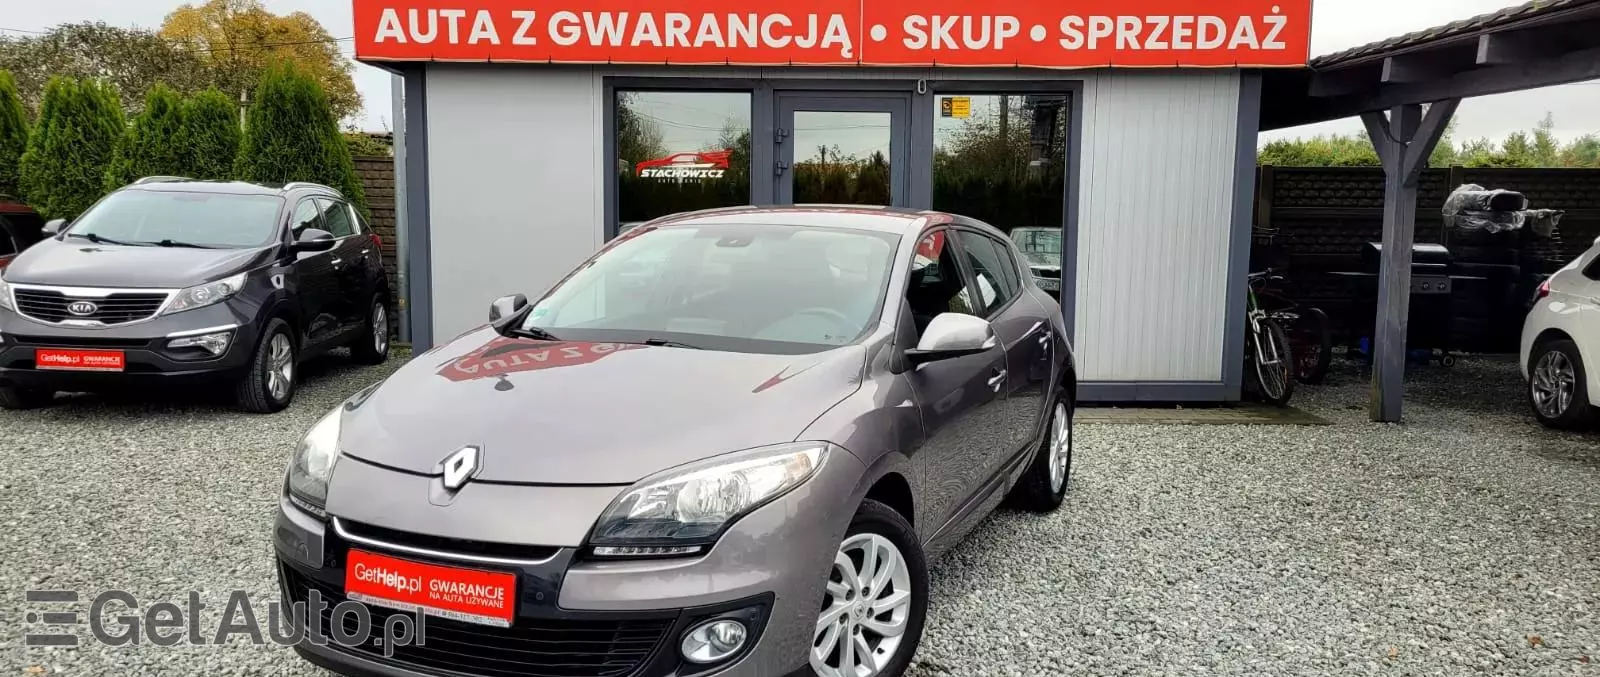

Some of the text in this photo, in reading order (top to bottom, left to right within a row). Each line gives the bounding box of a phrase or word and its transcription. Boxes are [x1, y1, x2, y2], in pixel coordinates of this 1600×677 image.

[375, 5, 1287, 59] AUTA Z GWARANCJĄ SKUP SPRZEDAŻ
[640, 169, 725, 178] STACHOWICZ
[72, 304, 92, 312] KIA
[354, 562, 505, 601] GetHelp.pl GWARANCJE
[429, 591, 441, 600] NA
[442, 593, 463, 603] AUTA
